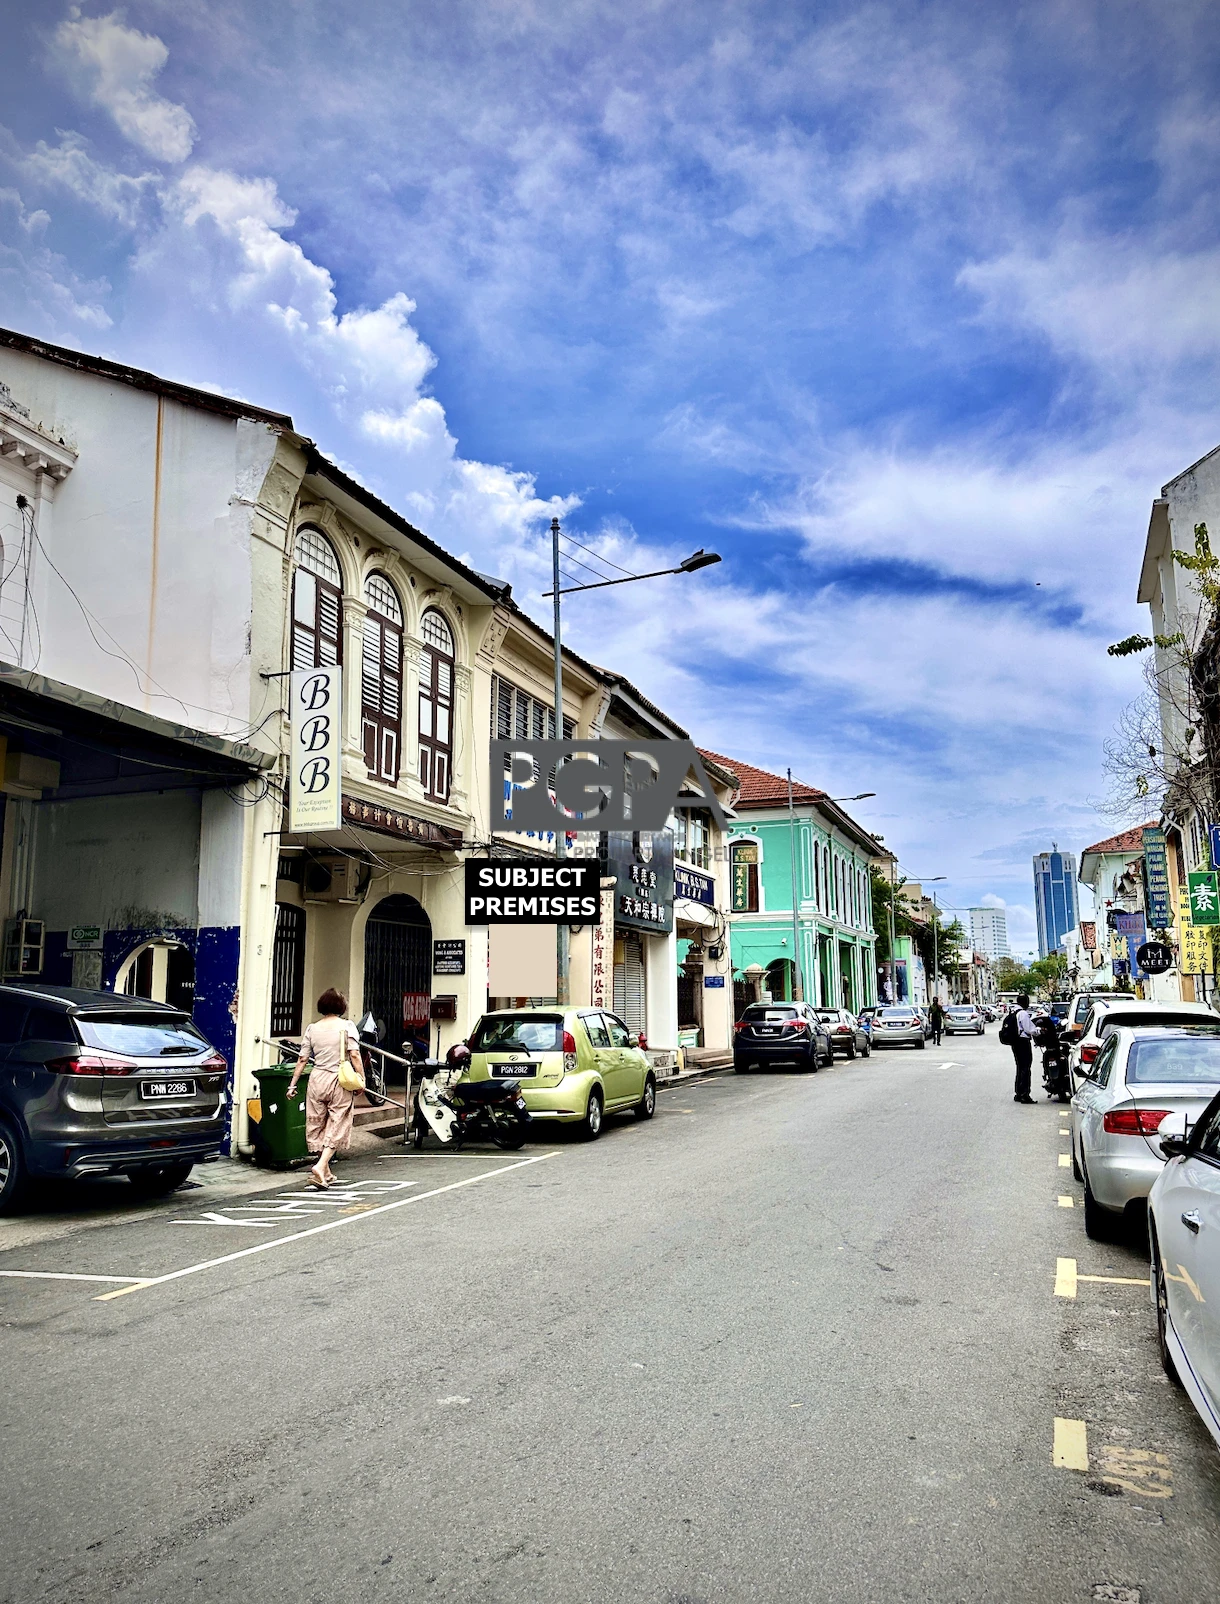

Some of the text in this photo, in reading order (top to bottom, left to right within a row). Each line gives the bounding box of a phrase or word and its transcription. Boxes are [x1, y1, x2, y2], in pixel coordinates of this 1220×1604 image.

[1150, 875, 1167, 883] PENANG
[1191, 883, 1216, 911] 素
[84, 930, 99, 938] NCR
[167, 1083, 188, 1093] 2286
